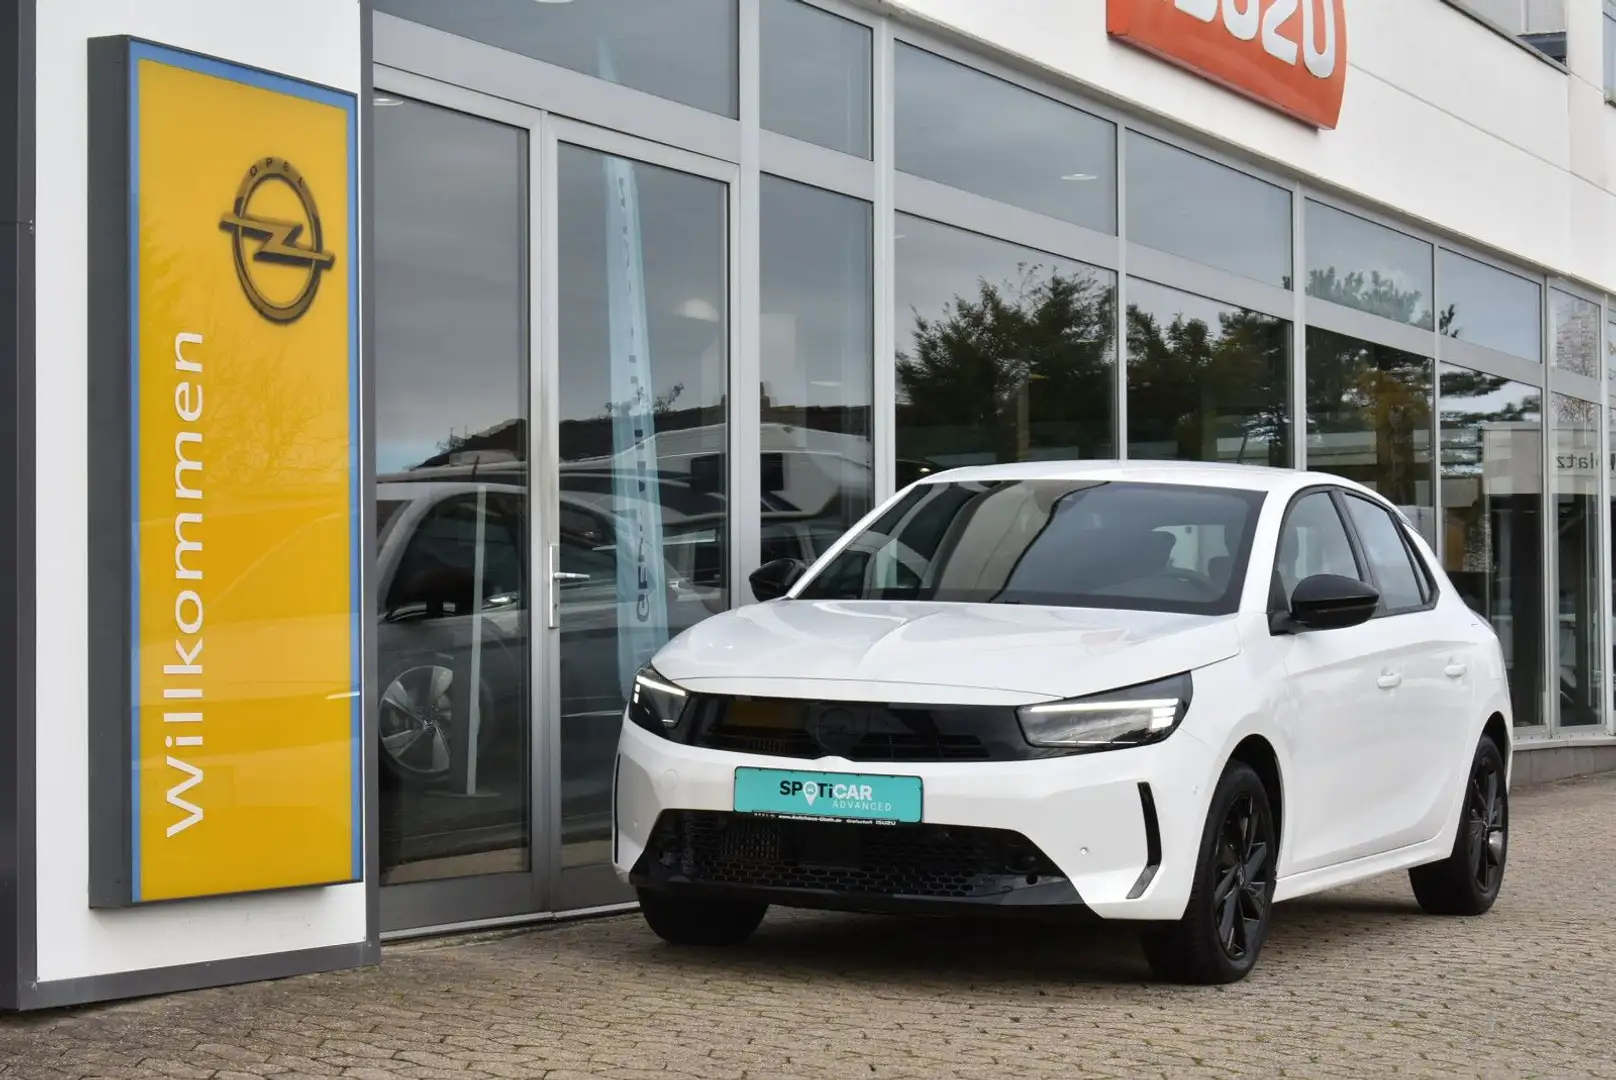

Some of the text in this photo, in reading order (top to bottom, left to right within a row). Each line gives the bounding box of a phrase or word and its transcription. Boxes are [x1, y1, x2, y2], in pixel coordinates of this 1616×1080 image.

[249, 157, 304, 189] OPEL
[163, 331, 204, 837] Willkommen
[832, 800, 892, 812] ADVANCED
